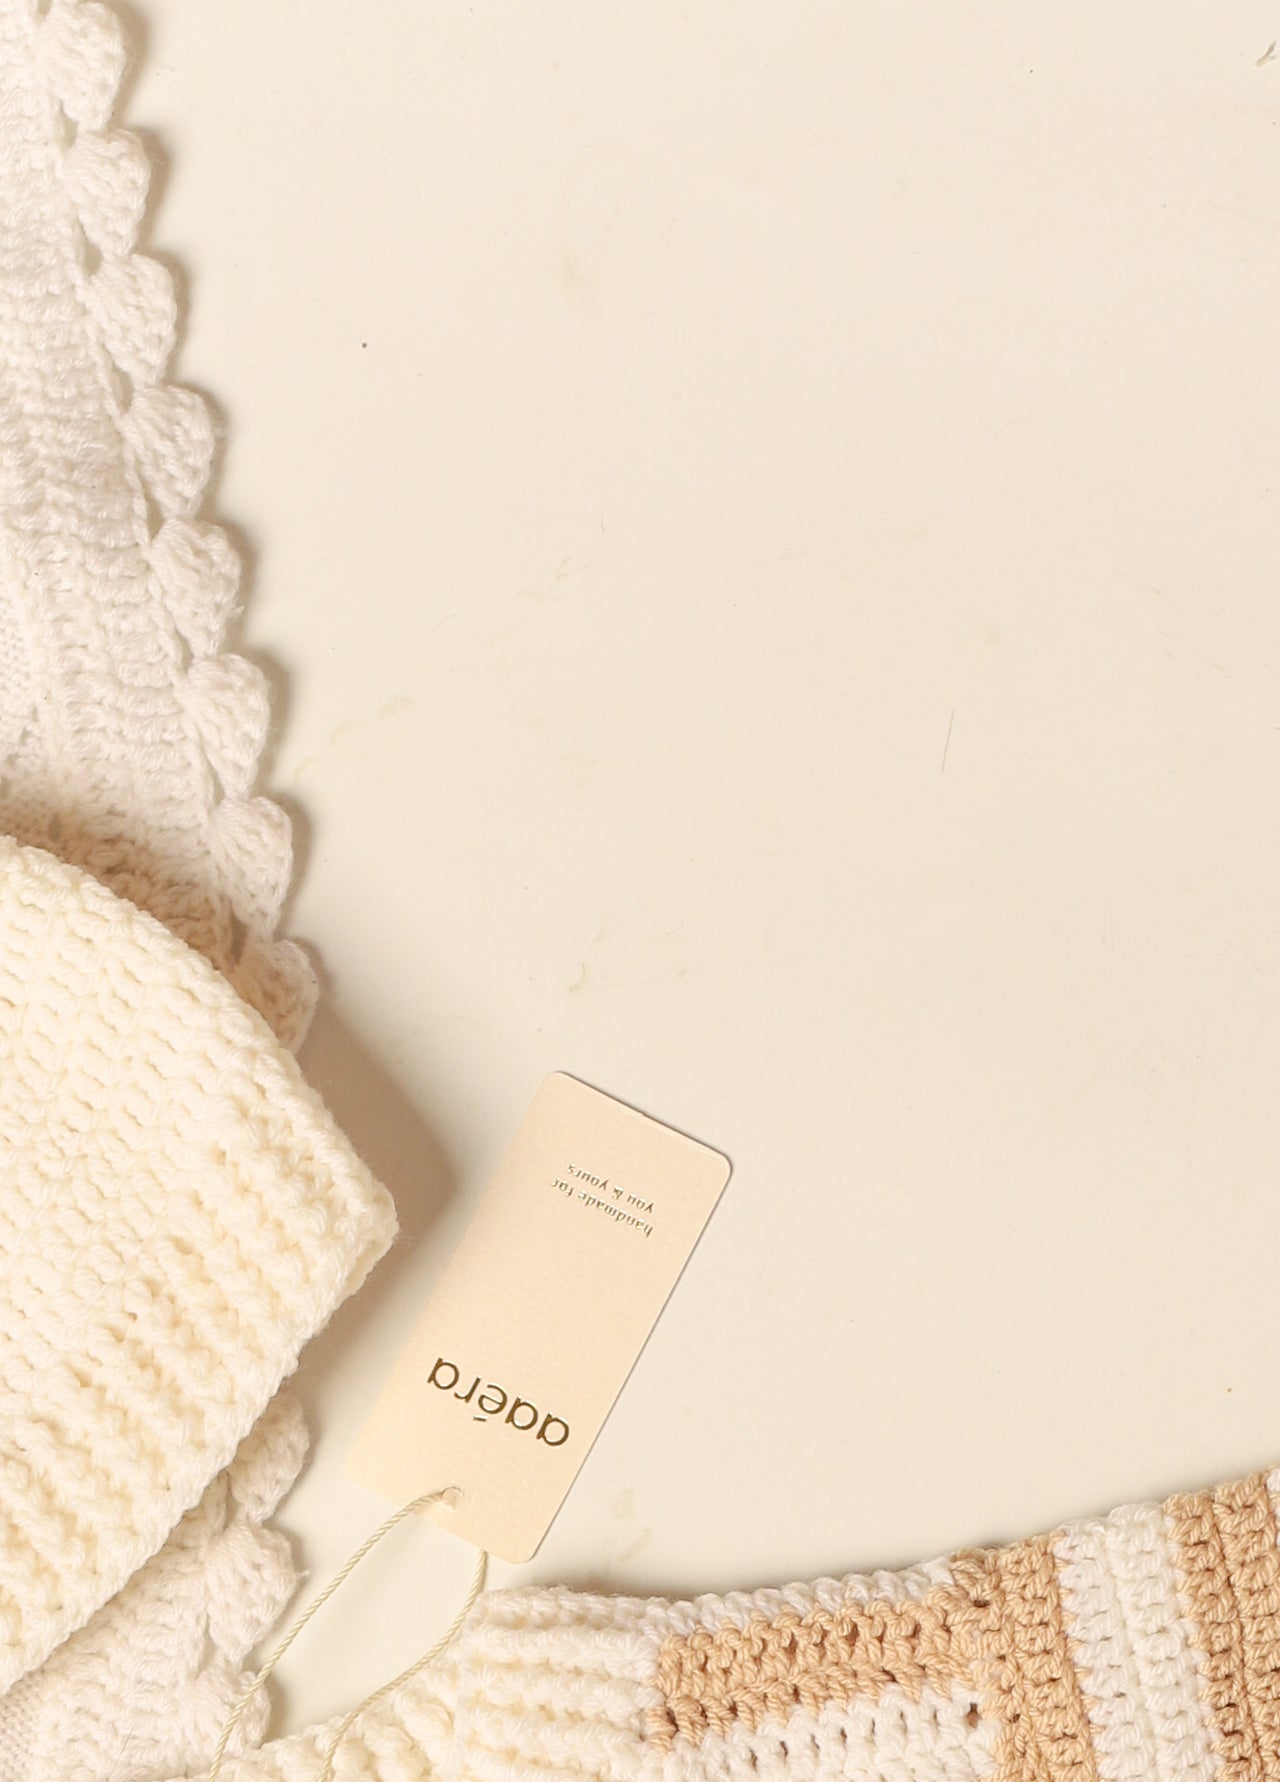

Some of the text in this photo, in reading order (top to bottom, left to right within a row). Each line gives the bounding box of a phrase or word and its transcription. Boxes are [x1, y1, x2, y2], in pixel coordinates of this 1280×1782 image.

[551, 1178, 654, 1238] handmade for
[566, 1164, 655, 1214] you & yours
[426, 1356, 571, 1447] aaéra
